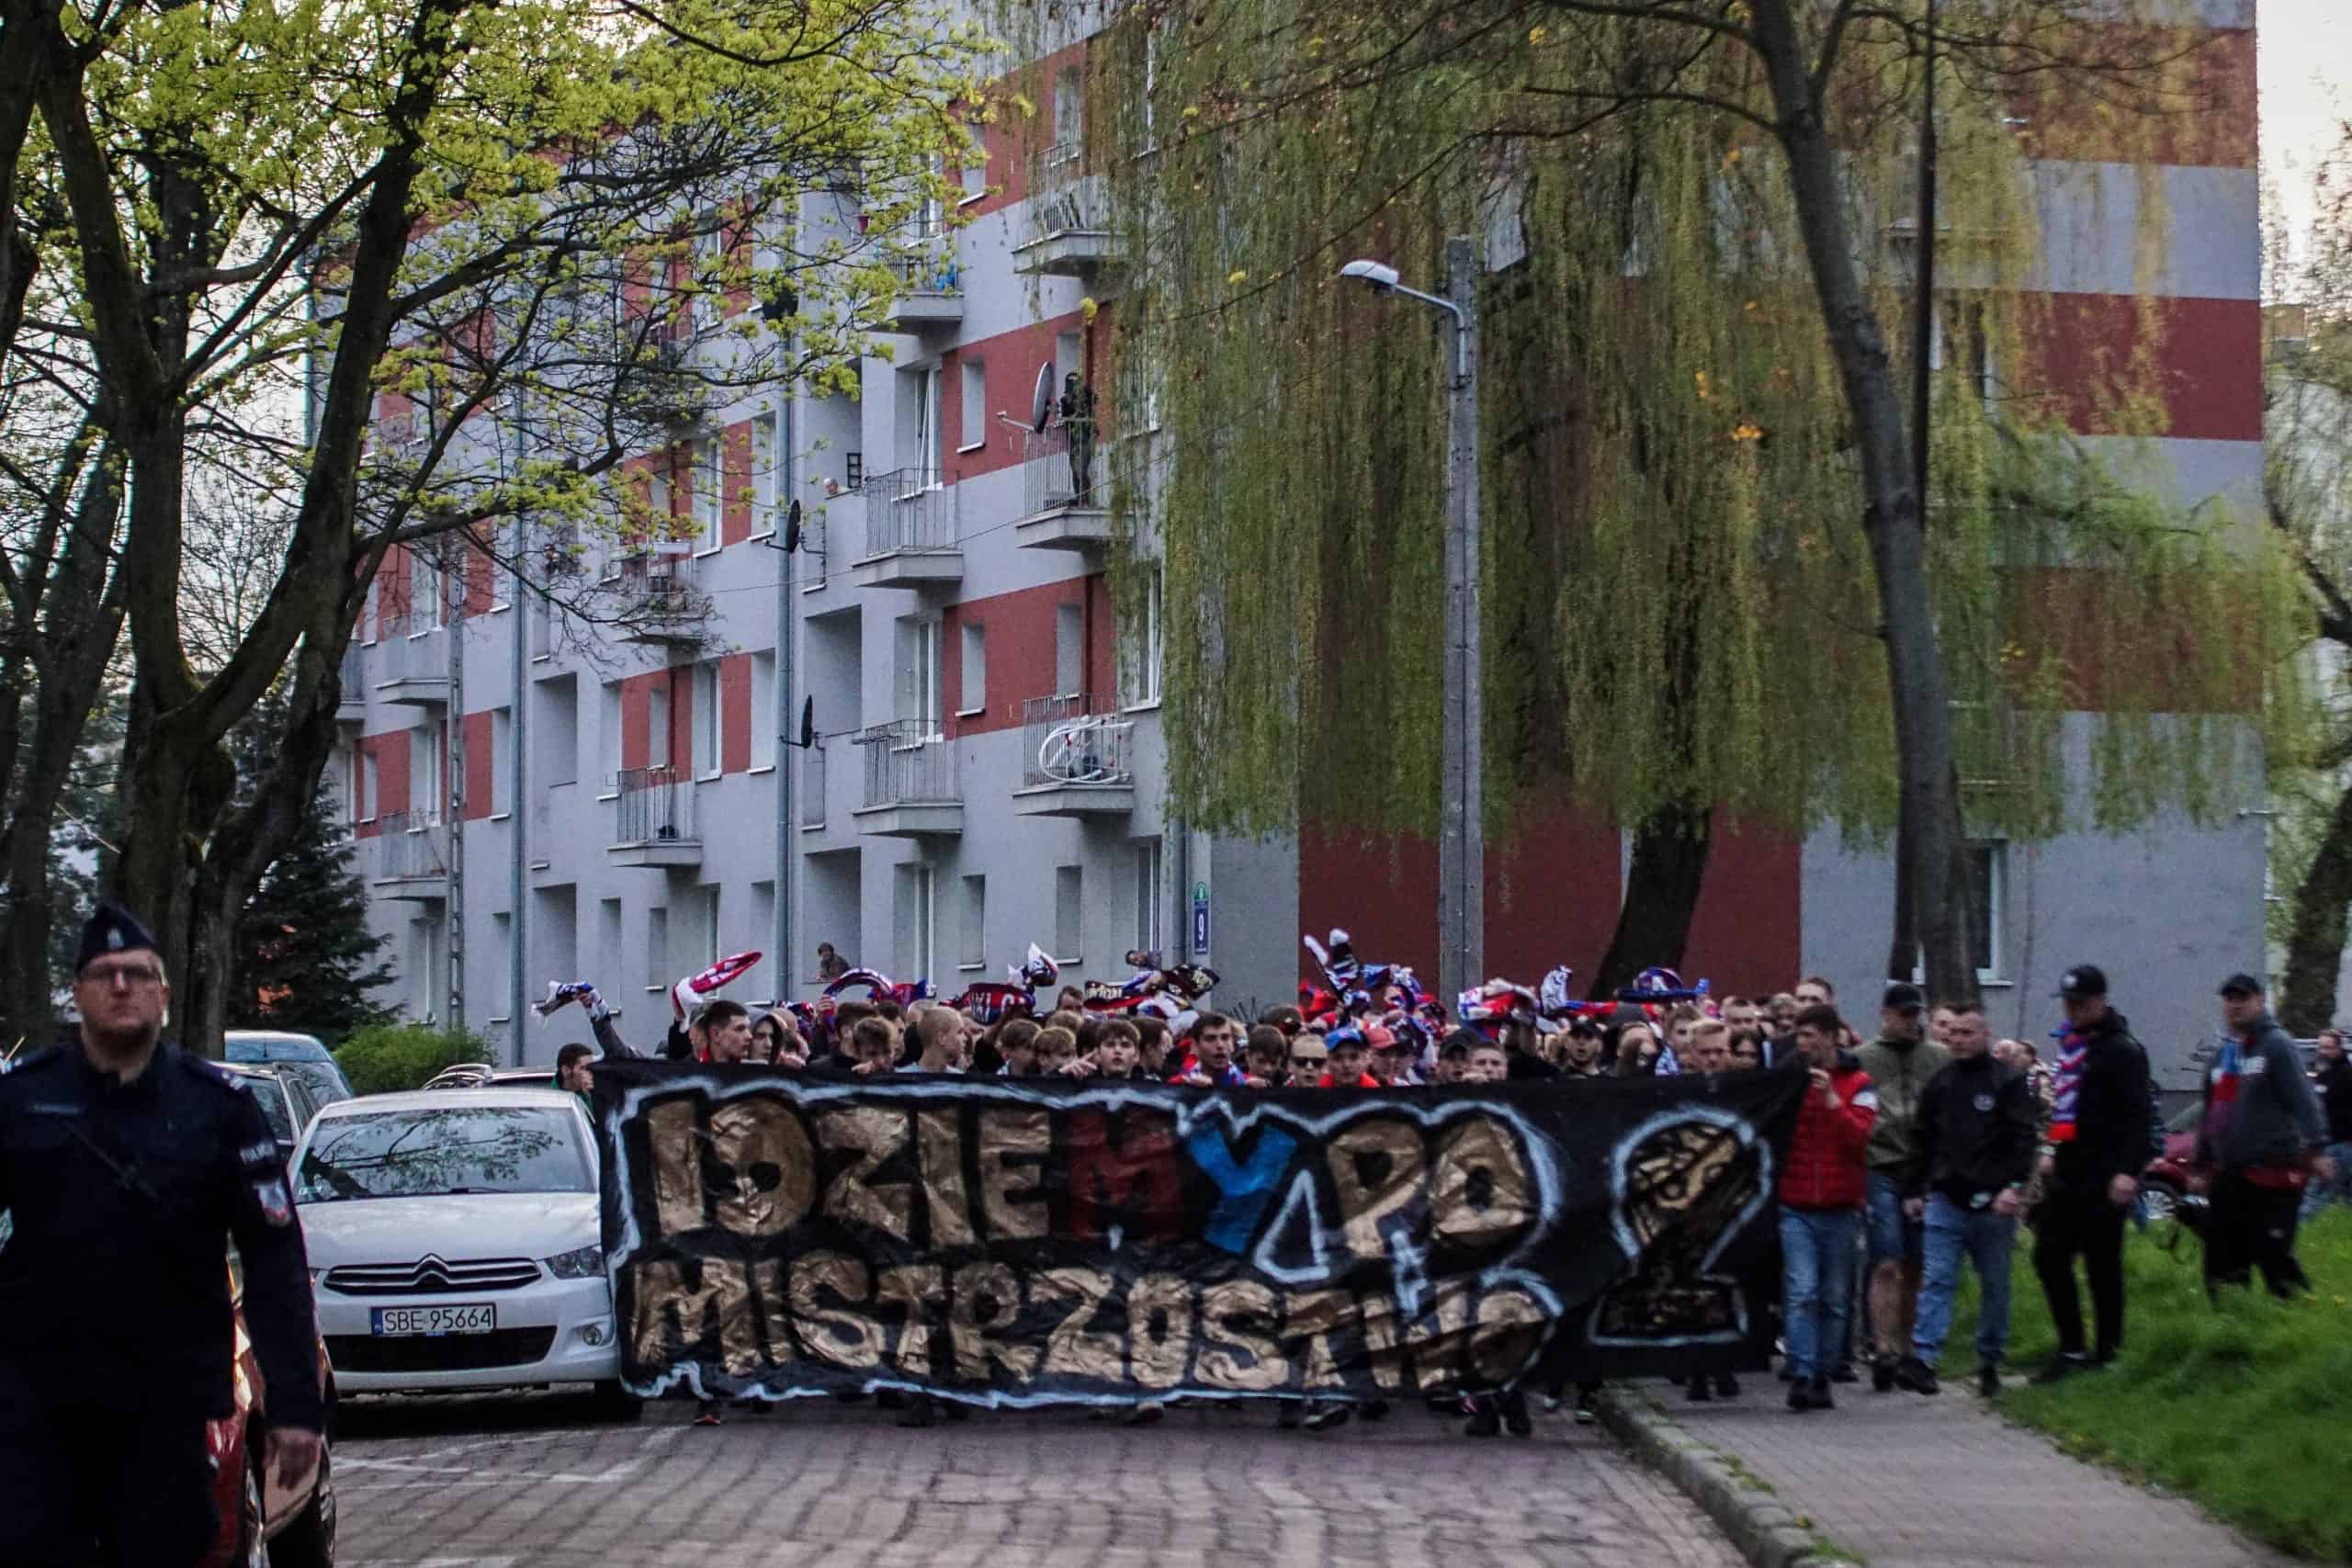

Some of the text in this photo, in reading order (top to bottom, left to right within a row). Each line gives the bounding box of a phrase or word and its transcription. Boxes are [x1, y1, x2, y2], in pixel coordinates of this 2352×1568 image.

[1198, 913, 1204, 942] 9
[648, 1100, 1536, 1259] IDZIEMY PO
[384, 1307, 492, 1331] SBE 95664
